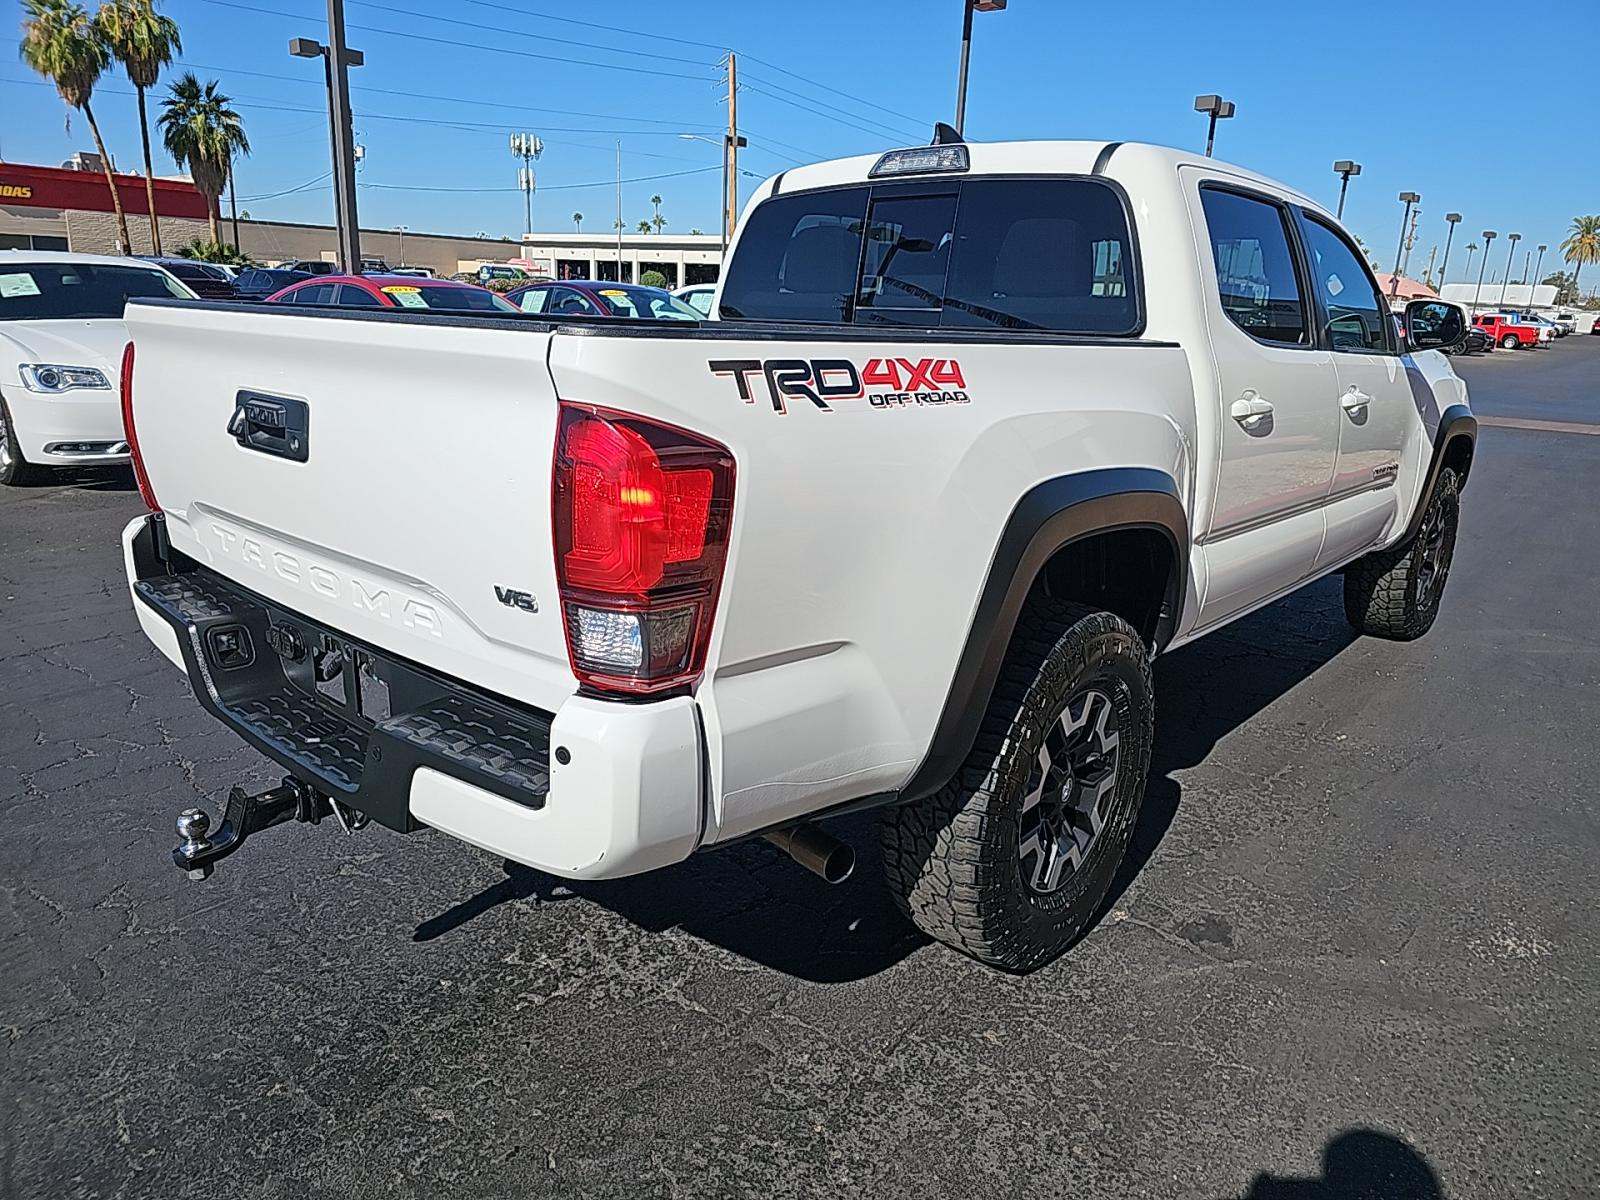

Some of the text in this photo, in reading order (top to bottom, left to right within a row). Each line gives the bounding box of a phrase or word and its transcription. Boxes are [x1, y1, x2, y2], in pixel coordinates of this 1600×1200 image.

[708, 359, 864, 415] TRD
[868, 391, 971, 409] OFF ROAD
[209, 522, 444, 638] TACOMA
[493, 585, 539, 614] V6
